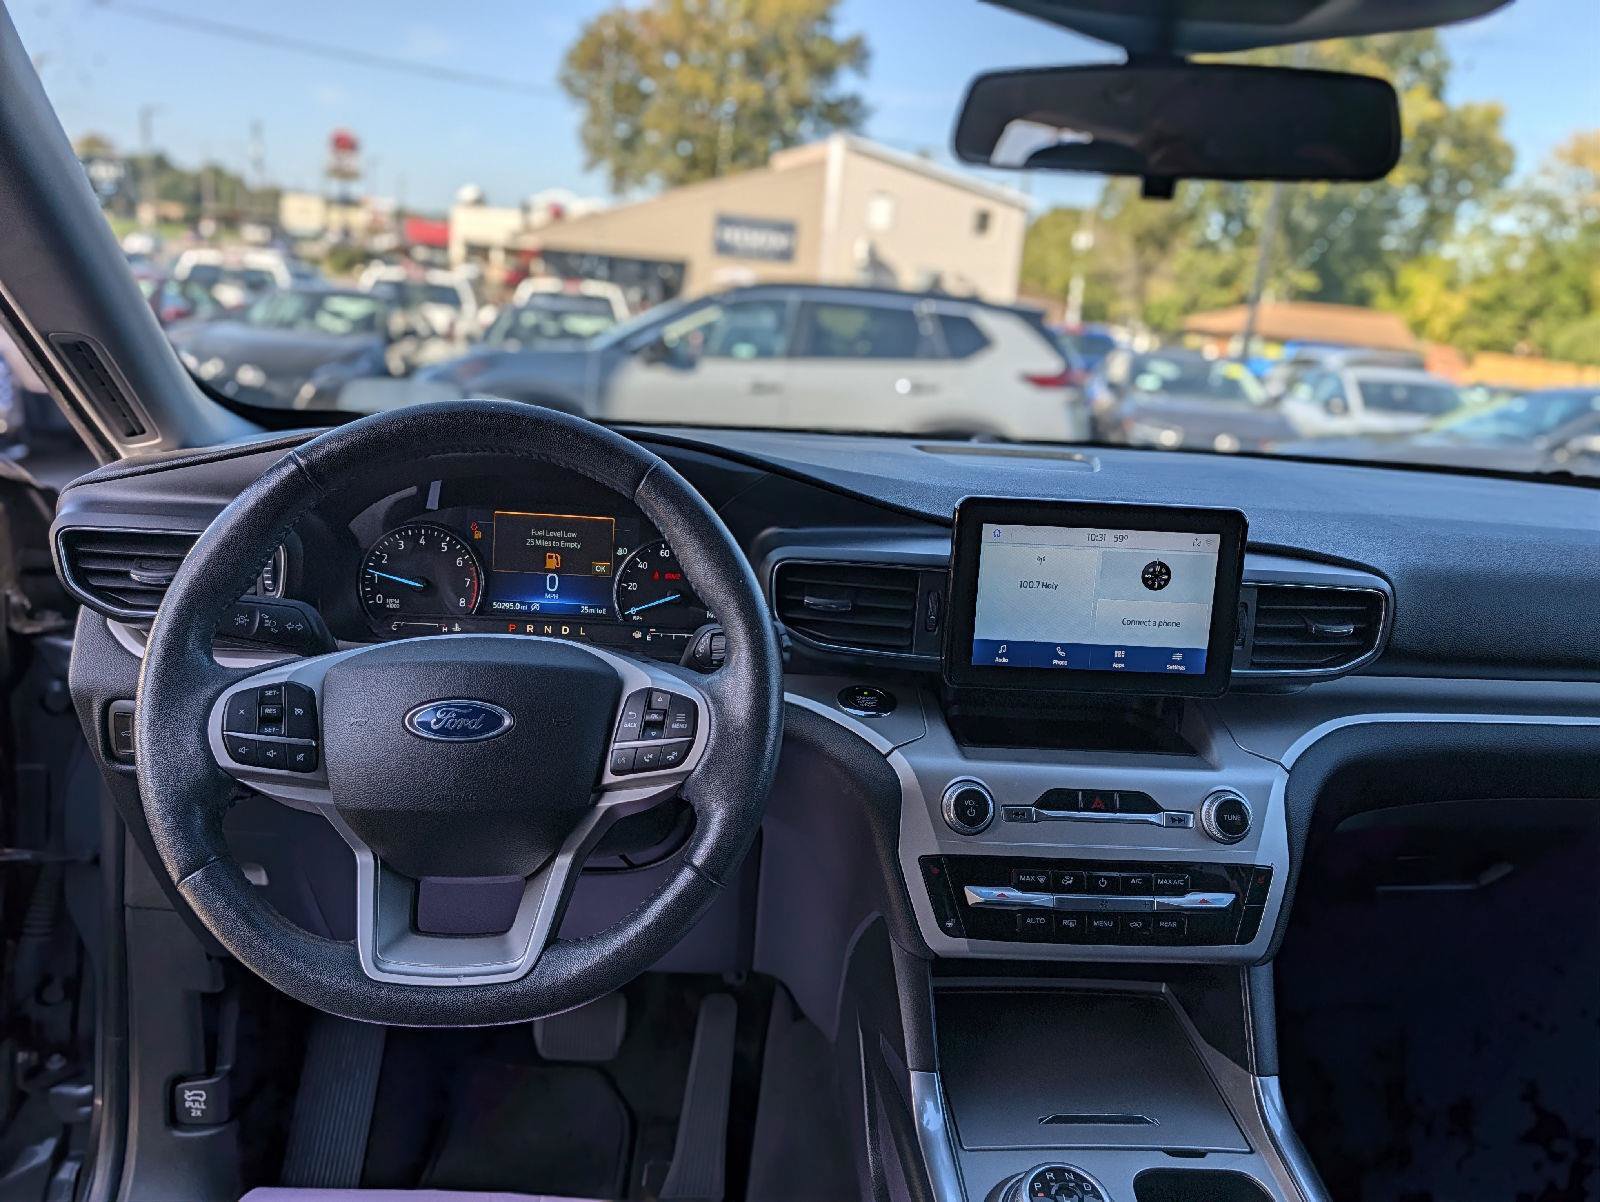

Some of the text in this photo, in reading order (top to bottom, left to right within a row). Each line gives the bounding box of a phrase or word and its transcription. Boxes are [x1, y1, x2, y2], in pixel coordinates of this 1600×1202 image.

[531, 528, 577, 538] Fuel Level Low
[1087, 533, 1106, 542] 10:31
[398, 540, 405, 550] 3
[419, 535, 426, 546] 4
[526, 538, 536, 546] 25
[536, 538, 552, 547] Miles
[560, 540, 582, 550] Empty
[441, 542, 448, 552] 5
[381, 553, 388, 564] 2
[660, 549, 670, 558] 60
[456, 557, 463, 567] 6
[638, 561, 648, 570] 40
[595, 565, 606, 573] OK
[464, 578, 471, 588] 7
[546, 573, 559, 592] 0
[627, 582, 638, 591] 20
[1019, 580, 1041, 589] 100.7
[376, 594, 383, 604] 0
[459, 597, 466, 607] 8
[1121, 617, 1152, 627] Connect
[1157, 619, 1181, 628] phone
[508, 623, 586, 635] P R N D L
[430, 707, 486, 730] Ford
[184, 1101, 207, 1109] PULL
[190, 1109, 202, 1117] 2X
[1034, 1172, 1092, 1191] P R N D
